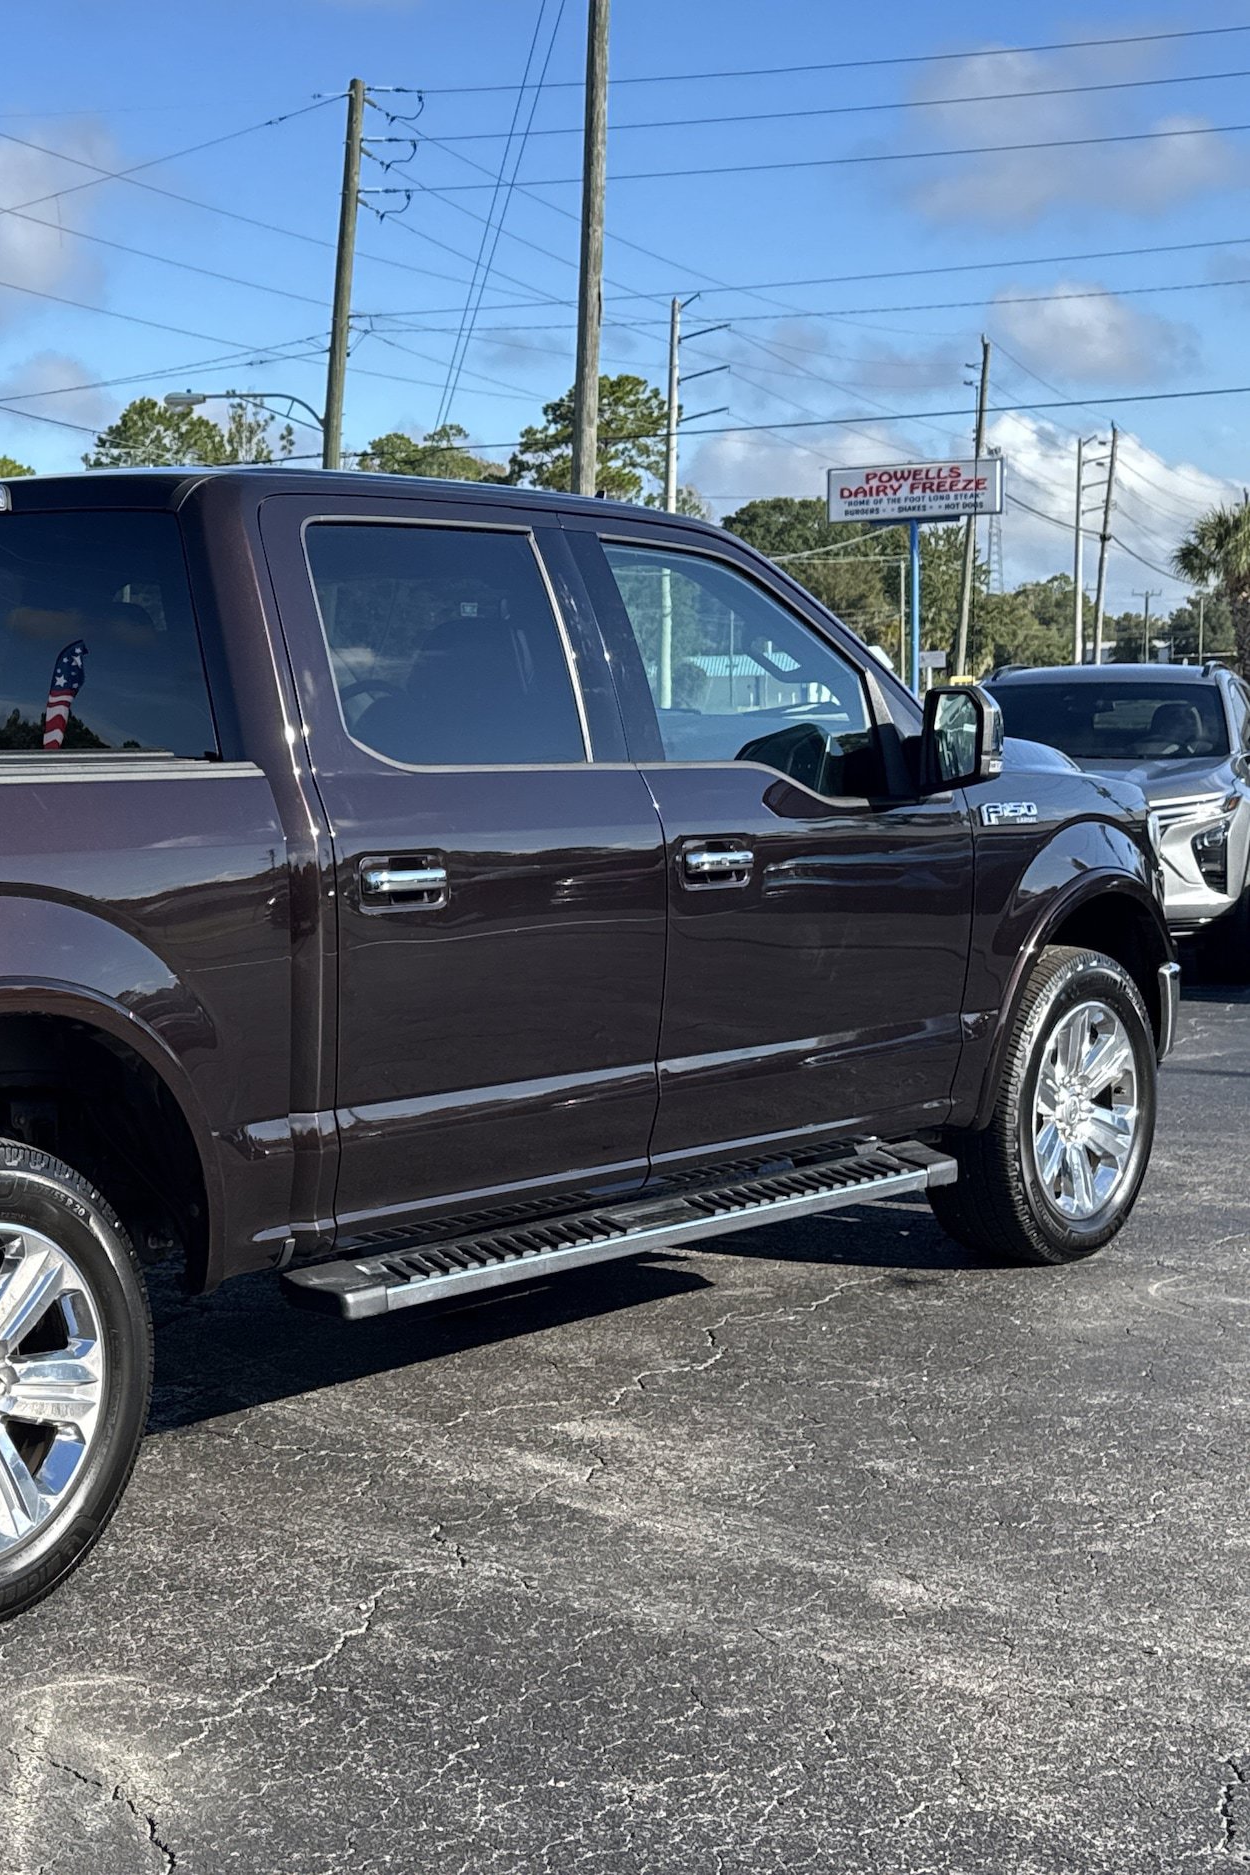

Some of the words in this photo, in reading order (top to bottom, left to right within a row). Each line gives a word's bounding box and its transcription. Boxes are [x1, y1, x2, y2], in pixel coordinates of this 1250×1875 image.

[865, 466, 962, 485] POWELLS
[840, 484, 903, 499] DAIRY
[909, 478, 988, 494] FREEZE
[873, 498, 884, 506] OF
[887, 497, 901, 505] THE
[904, 495, 926, 504] FOOT
[844, 507, 880, 517] BURGERS
[897, 504, 927, 513] SHAKES
[944, 502, 960, 511] HOT
[962, 501, 984, 510] DOGS
[73, 1203, 86, 1217] 20
